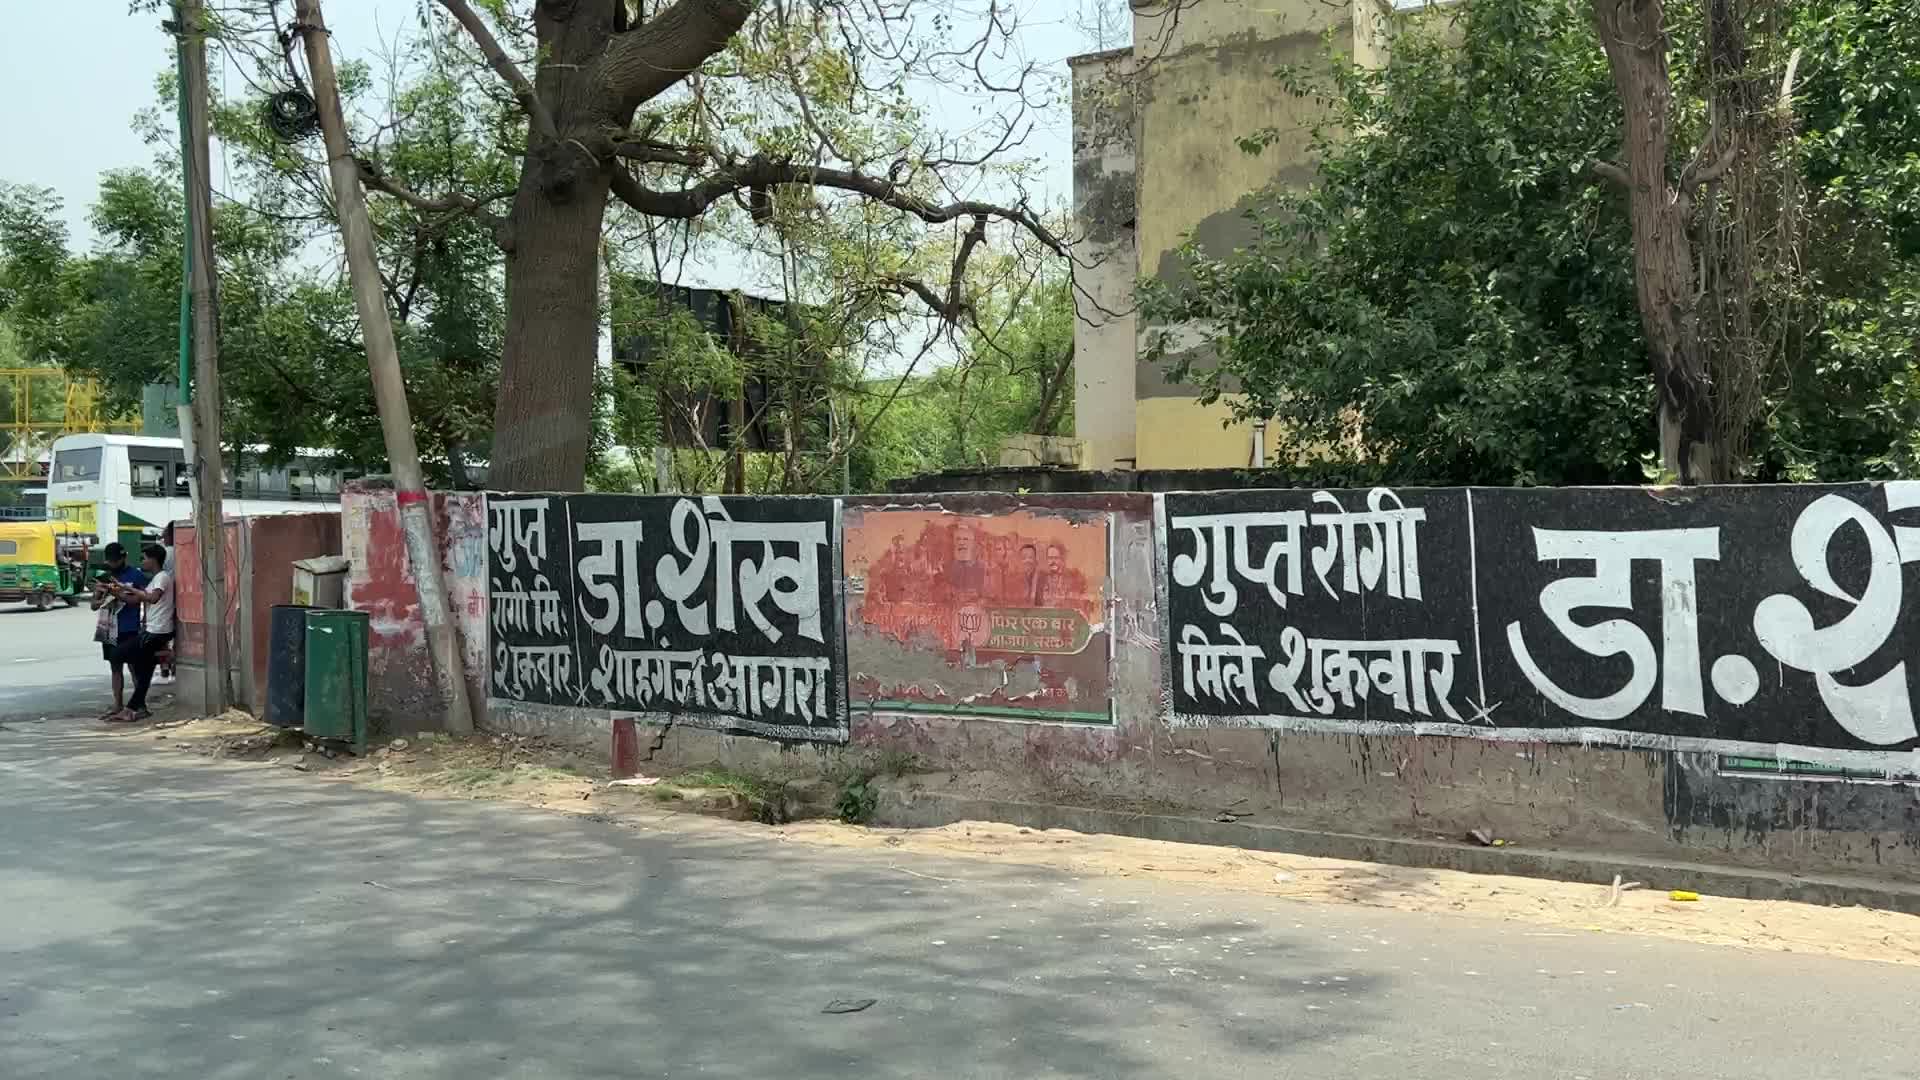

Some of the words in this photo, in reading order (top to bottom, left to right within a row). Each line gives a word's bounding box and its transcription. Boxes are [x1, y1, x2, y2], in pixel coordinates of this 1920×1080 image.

[489, 498, 549, 573] गुप्त
[1172, 510, 1307, 617] गुप्त
[1311, 487, 1426, 601] रोगी
[1022, 615, 1048, 634] एक
[707, 652, 832, 725] आगरा
[1177, 623, 1266, 711] मिले
